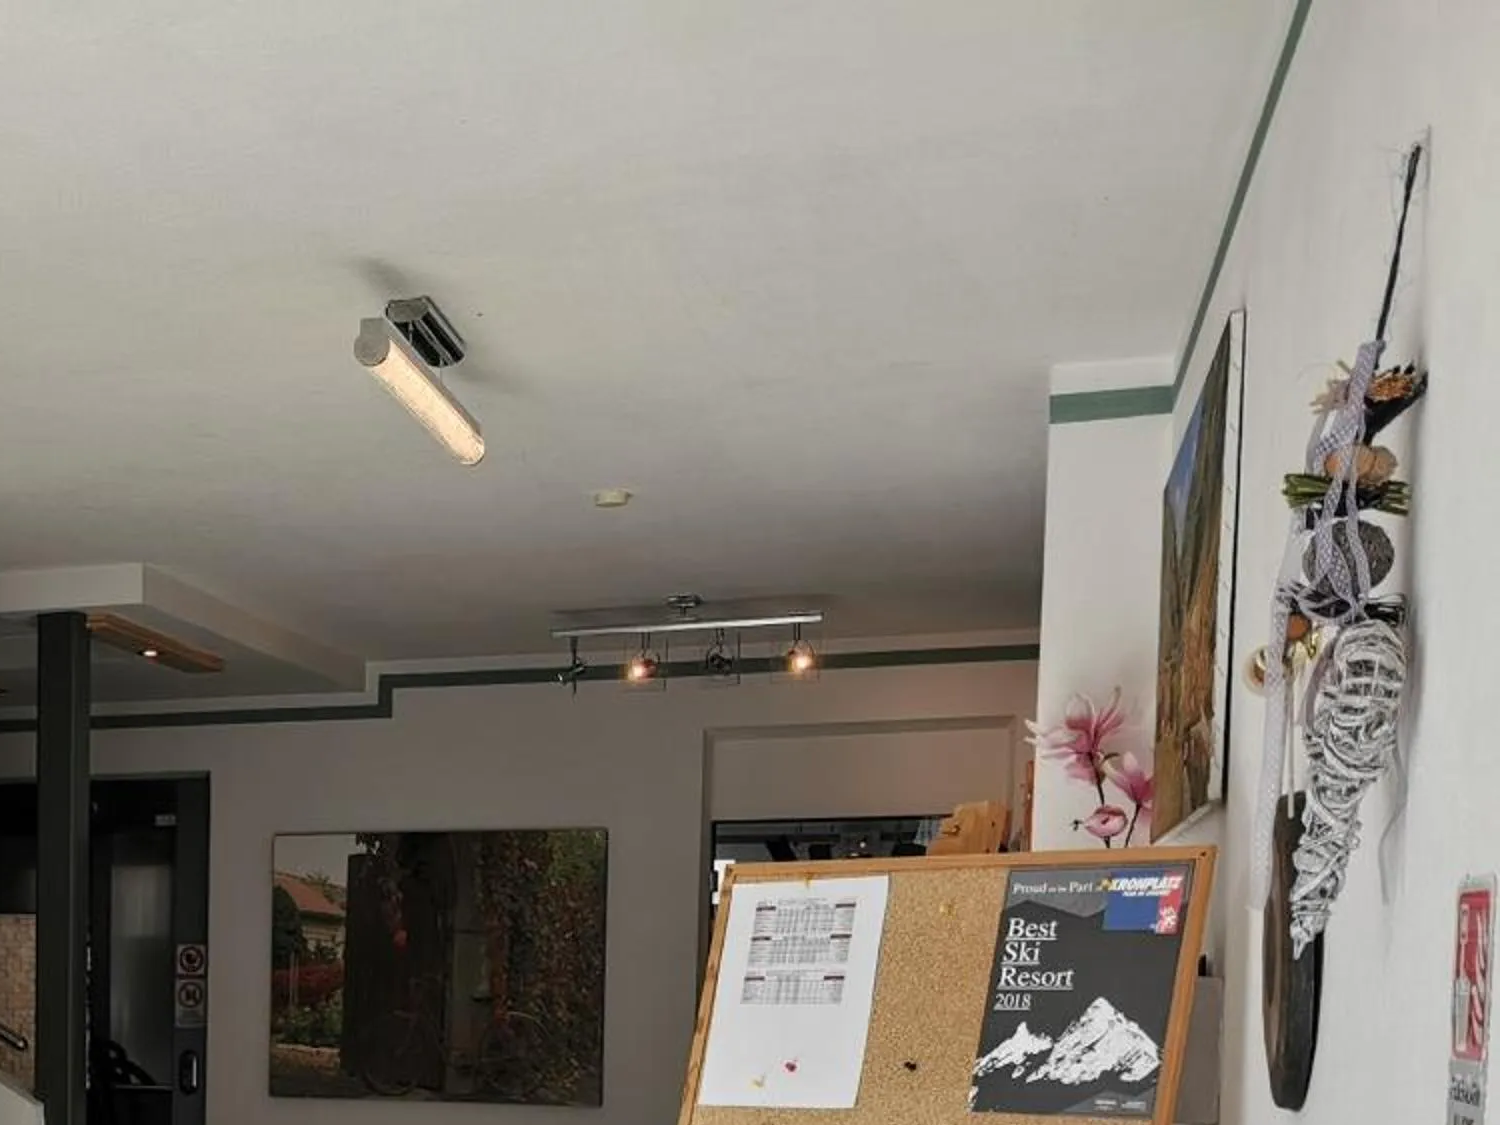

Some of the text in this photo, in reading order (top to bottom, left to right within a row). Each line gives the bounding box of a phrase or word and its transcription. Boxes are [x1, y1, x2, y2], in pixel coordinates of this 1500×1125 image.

[1012, 882, 1048, 894] Proud
[1069, 881, 1094, 893] Part
[1008, 917, 1058, 938] Best
[1002, 941, 1041, 962] Ski
[999, 967, 1075, 988] Resort
[995, 993, 1032, 1009] 2018
